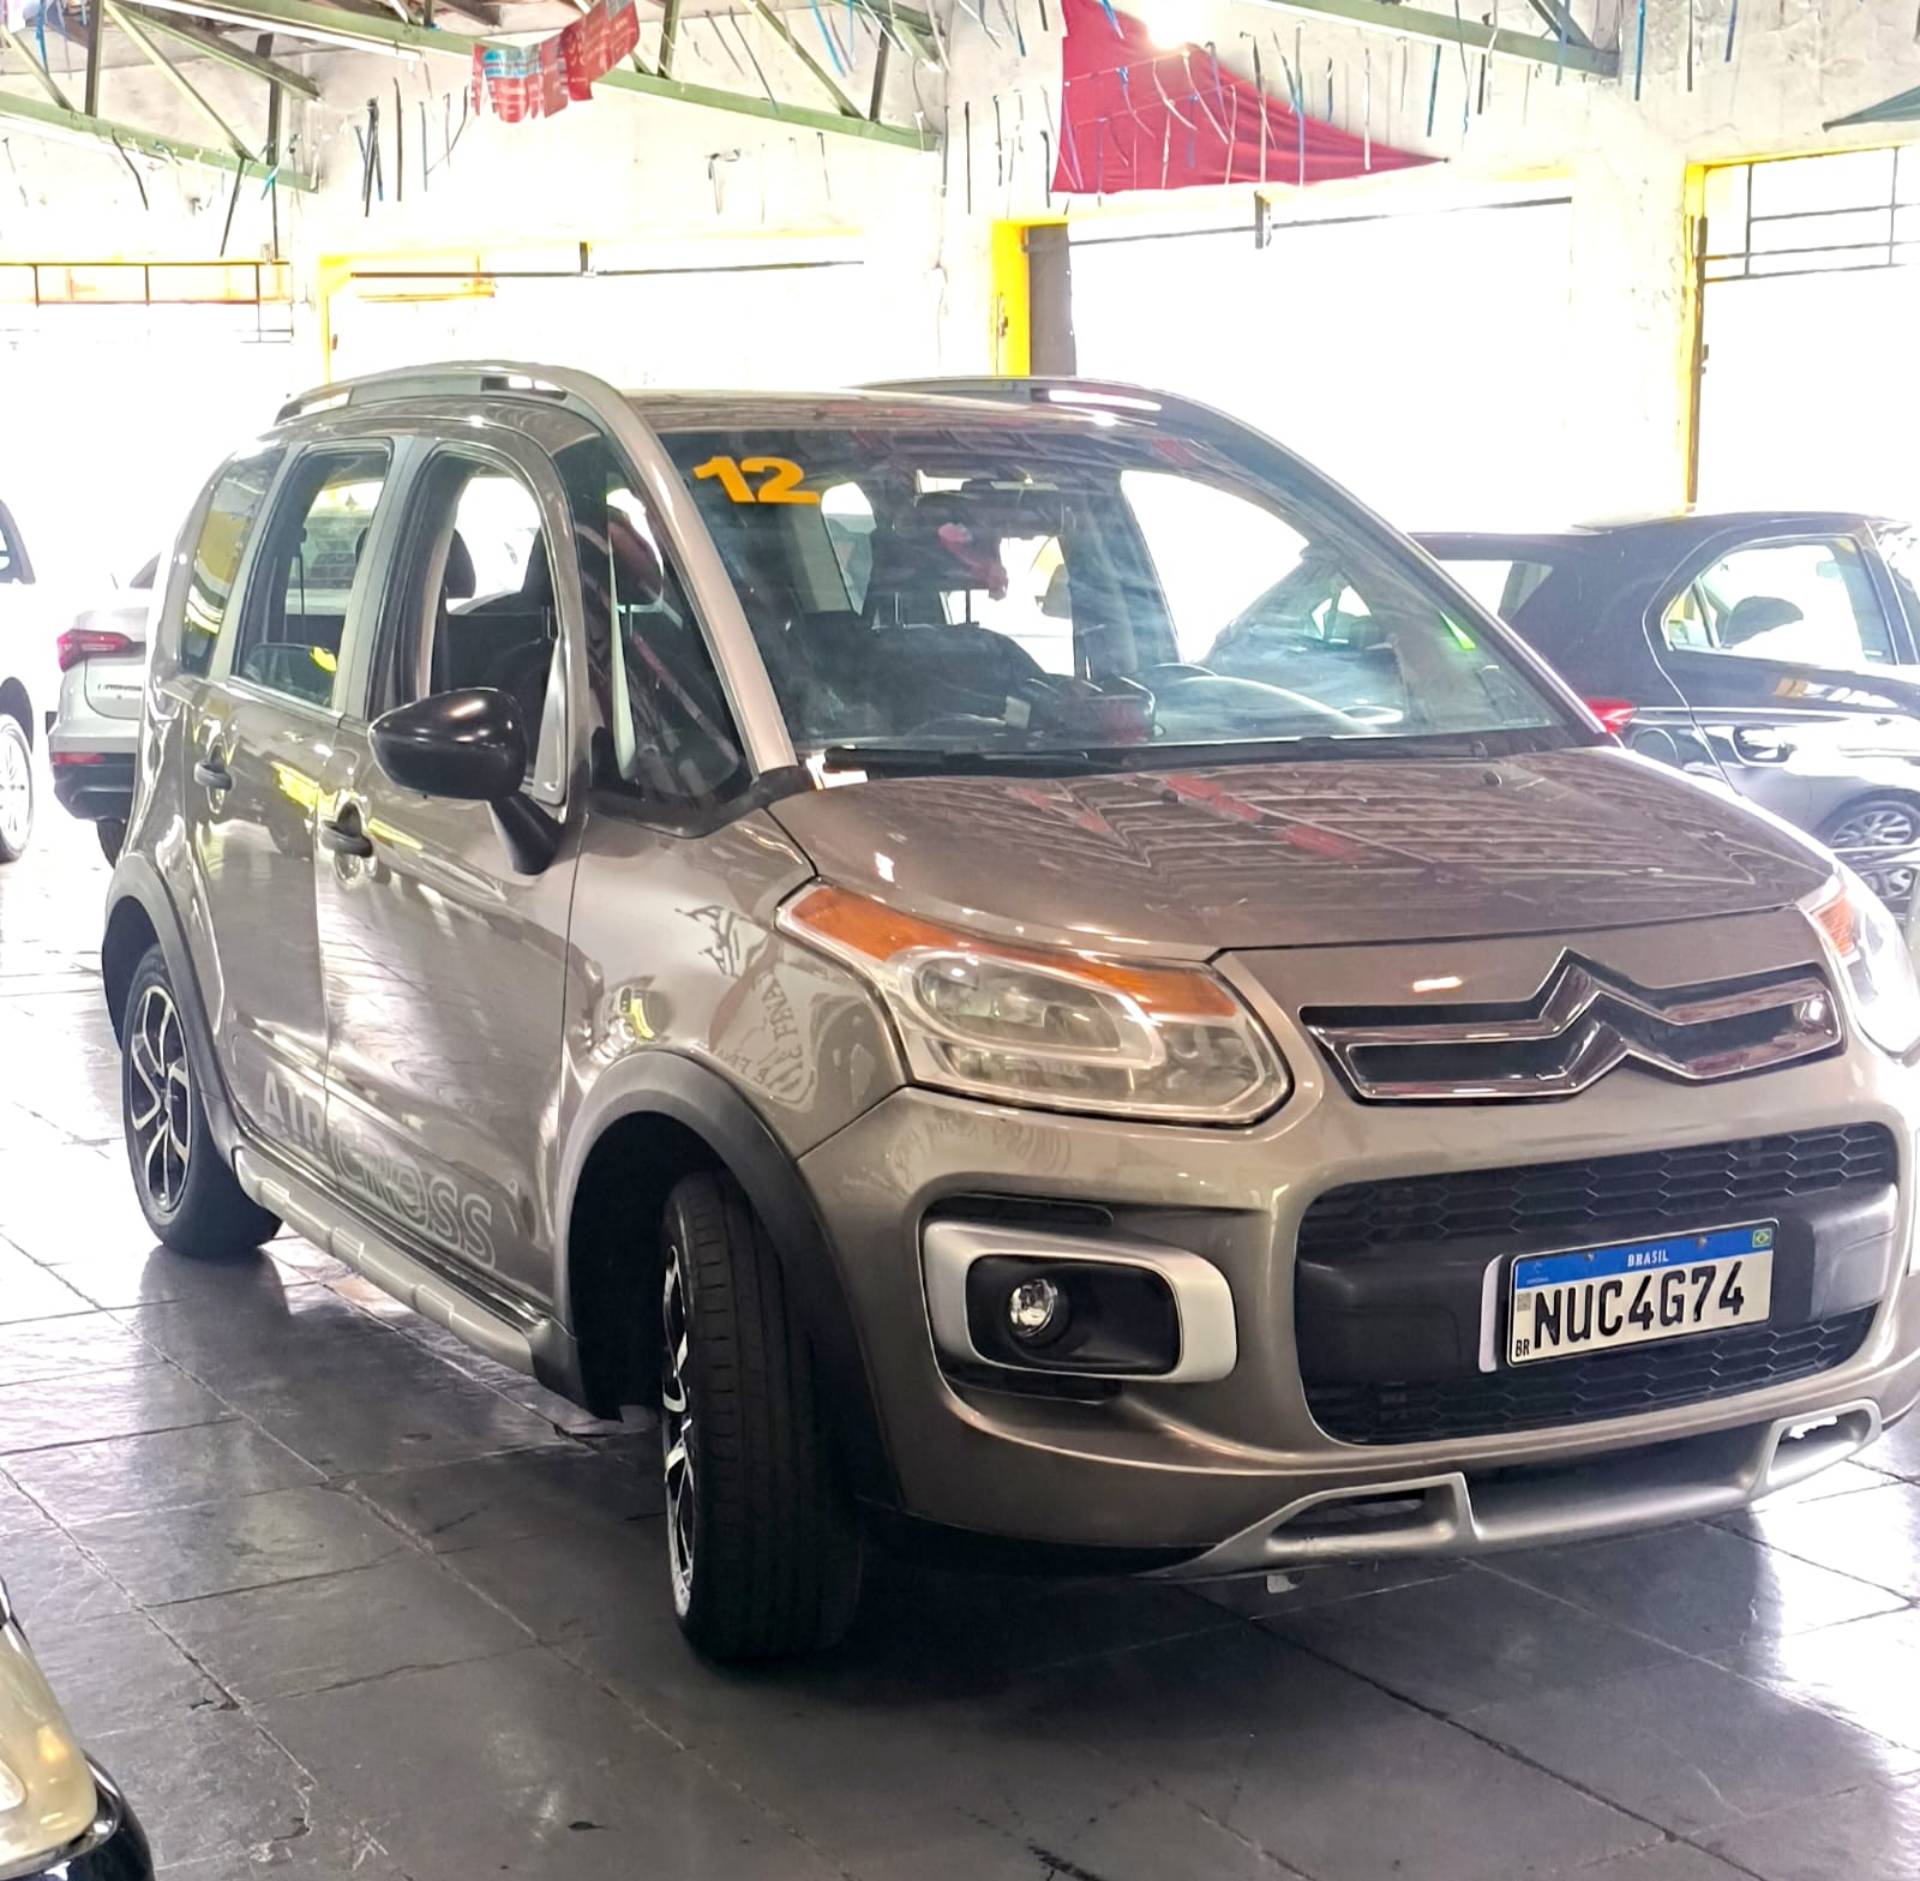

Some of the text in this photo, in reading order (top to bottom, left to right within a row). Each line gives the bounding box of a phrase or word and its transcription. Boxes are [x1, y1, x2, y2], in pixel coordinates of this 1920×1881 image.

[693, 455, 820, 504] 12
[1627, 1248, 1670, 1268] BRASIL
[1534, 1260, 1745, 1349] NUC4G74
[1515, 1338, 1531, 1358] BR
